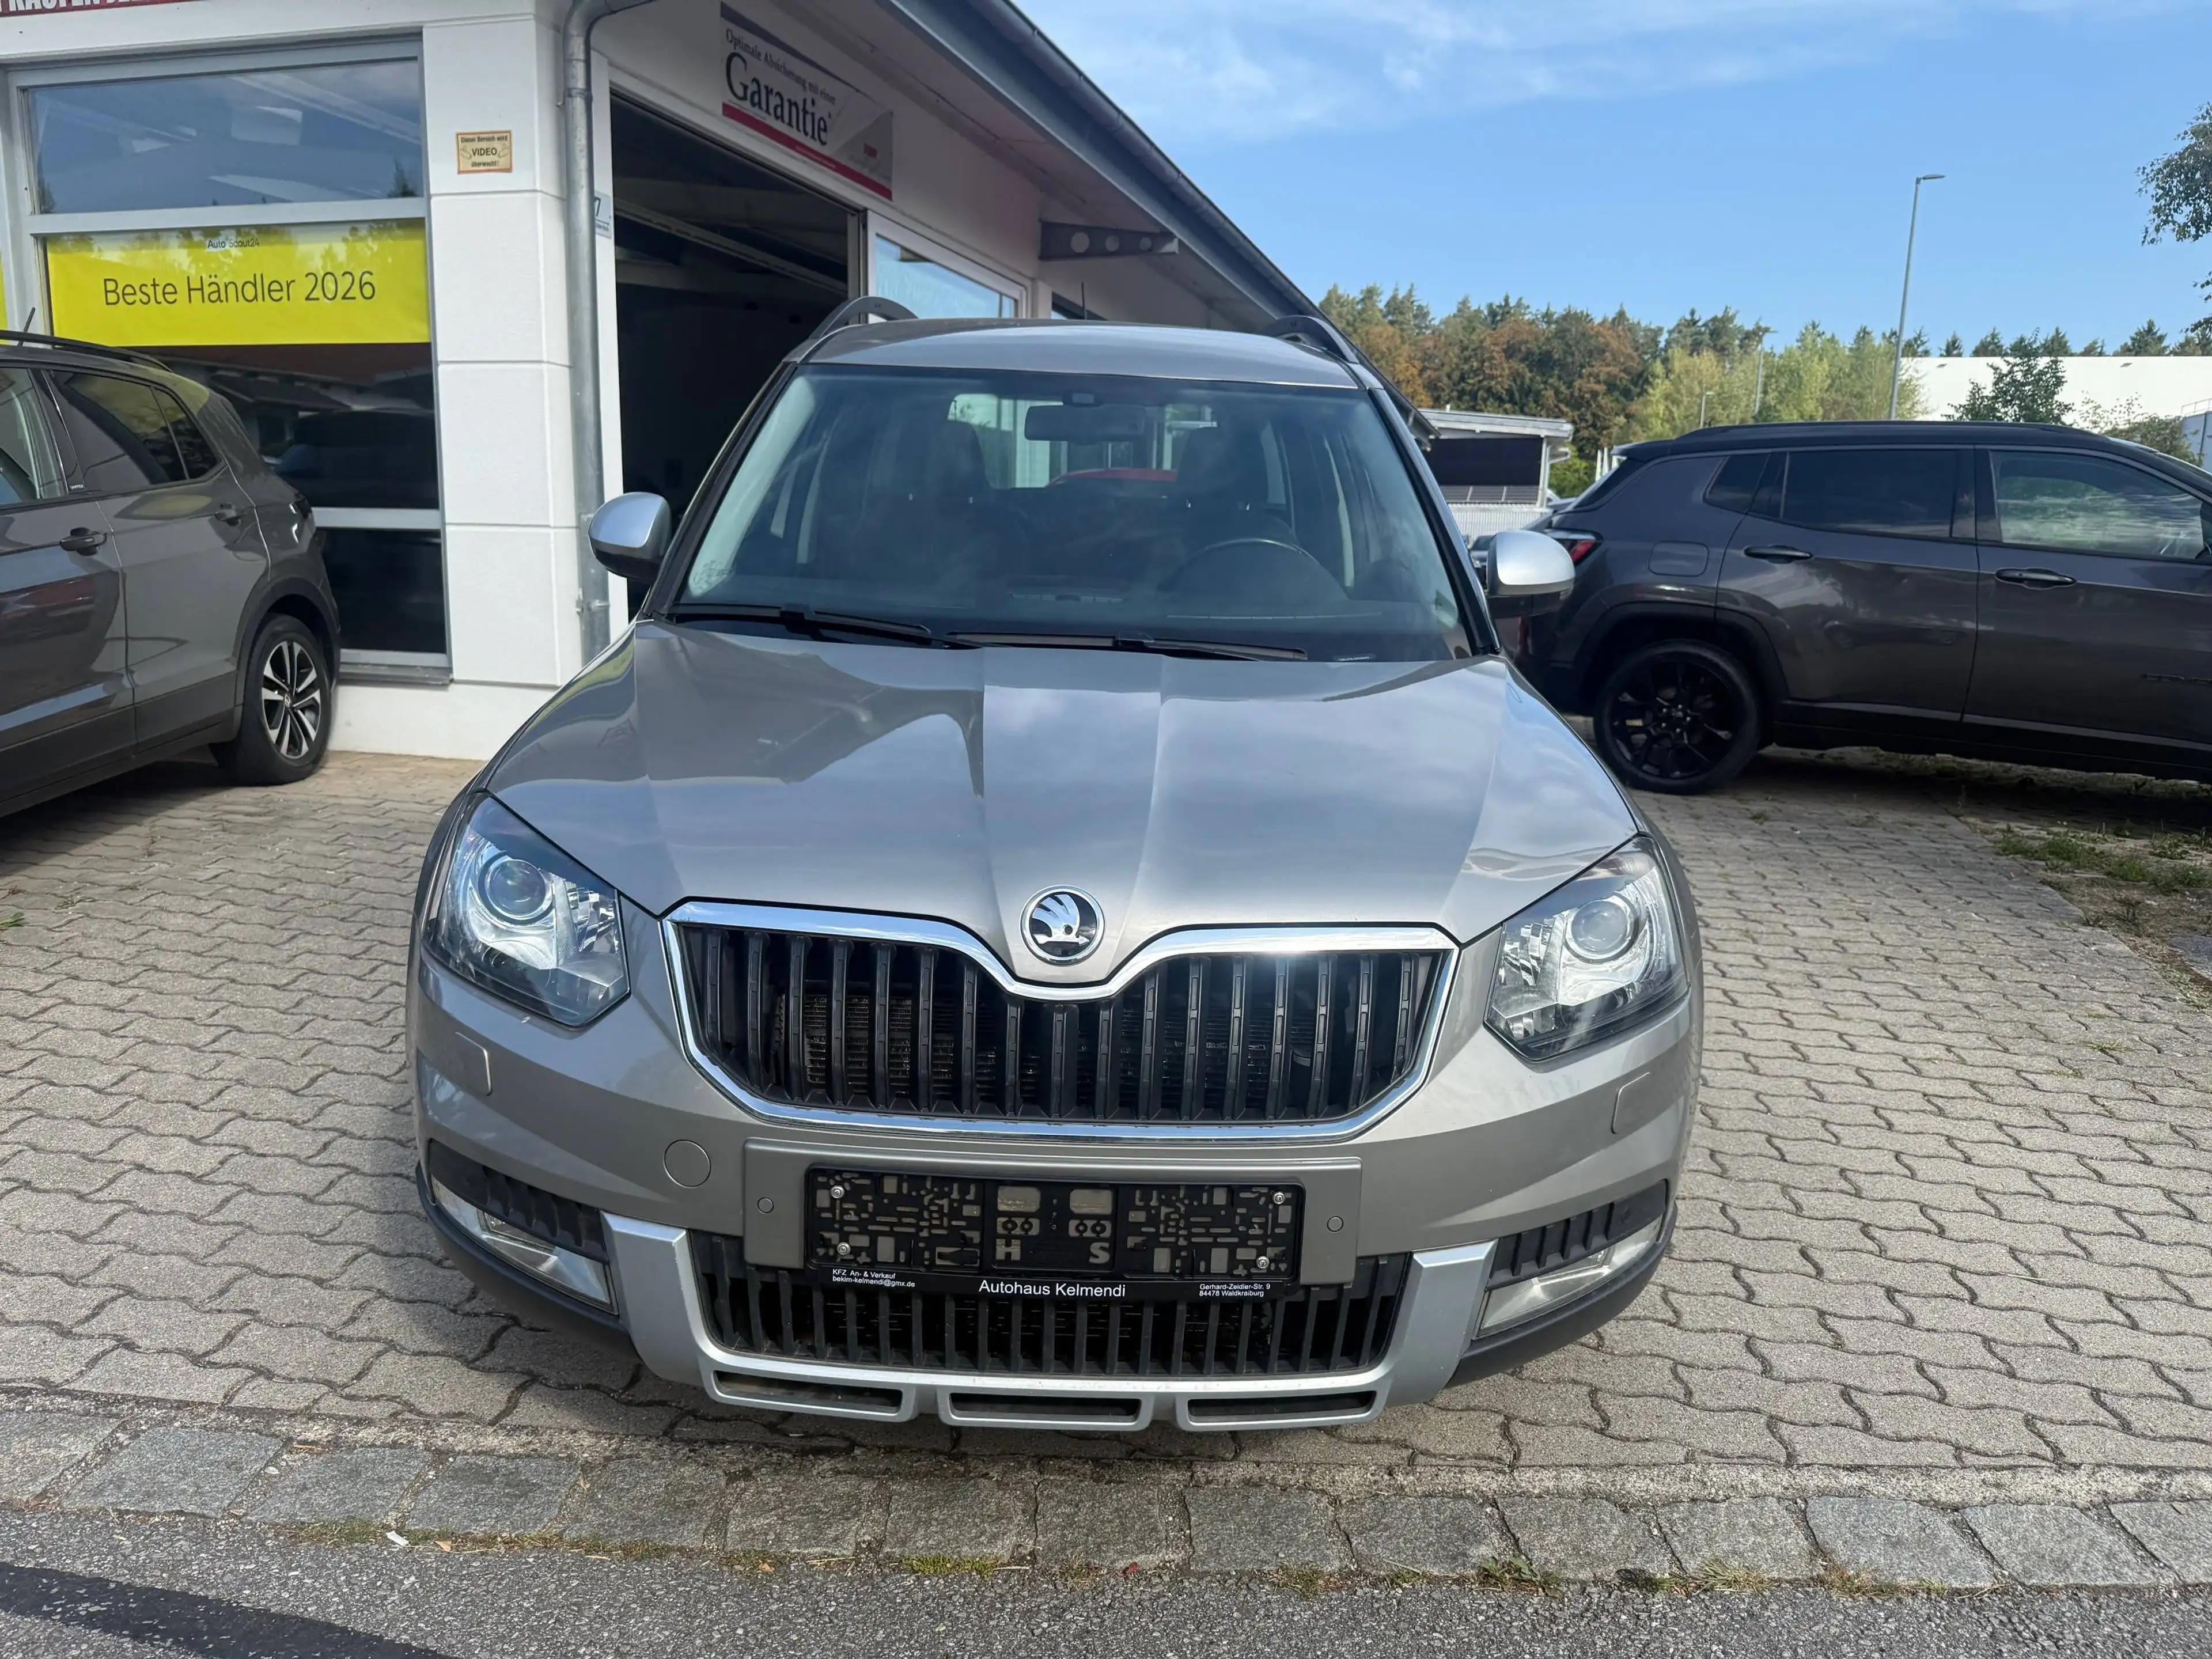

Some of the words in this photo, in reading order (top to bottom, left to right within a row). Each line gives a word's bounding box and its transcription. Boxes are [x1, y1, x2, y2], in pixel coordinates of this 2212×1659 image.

[472, 147, 497, 156] VIDEO
[104, 278, 177, 305] Beste
[187, 273, 295, 303] Händler
[304, 271, 376, 301] 2026
[832, 1275, 915, 1287] bekim-kelmendi@gmx.de
[870, 1271, 896, 1279] Verkauf
[979, 1280, 1050, 1295] Autohaus
[1055, 1283, 1126, 1297] Kelmendi
